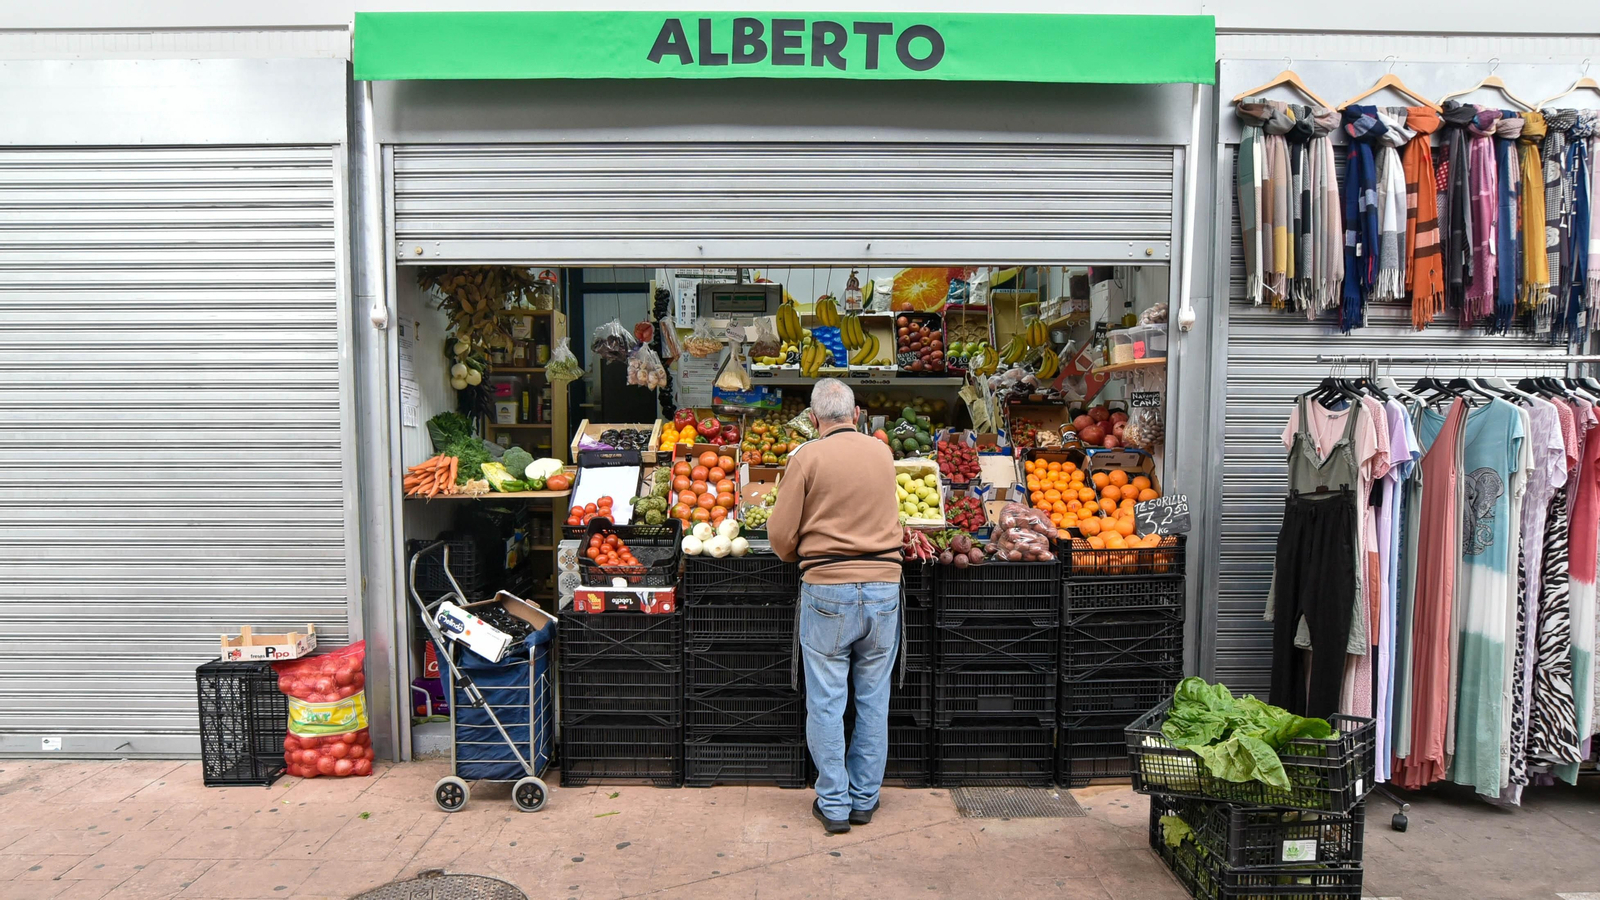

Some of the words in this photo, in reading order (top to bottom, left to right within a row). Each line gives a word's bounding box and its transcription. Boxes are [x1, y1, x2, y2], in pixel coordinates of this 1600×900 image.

[646, 17, 945, 71] ALBERTO
[1134, 494, 1187, 514] TESORILLO
[265, 646, 290, 659] Pipo
